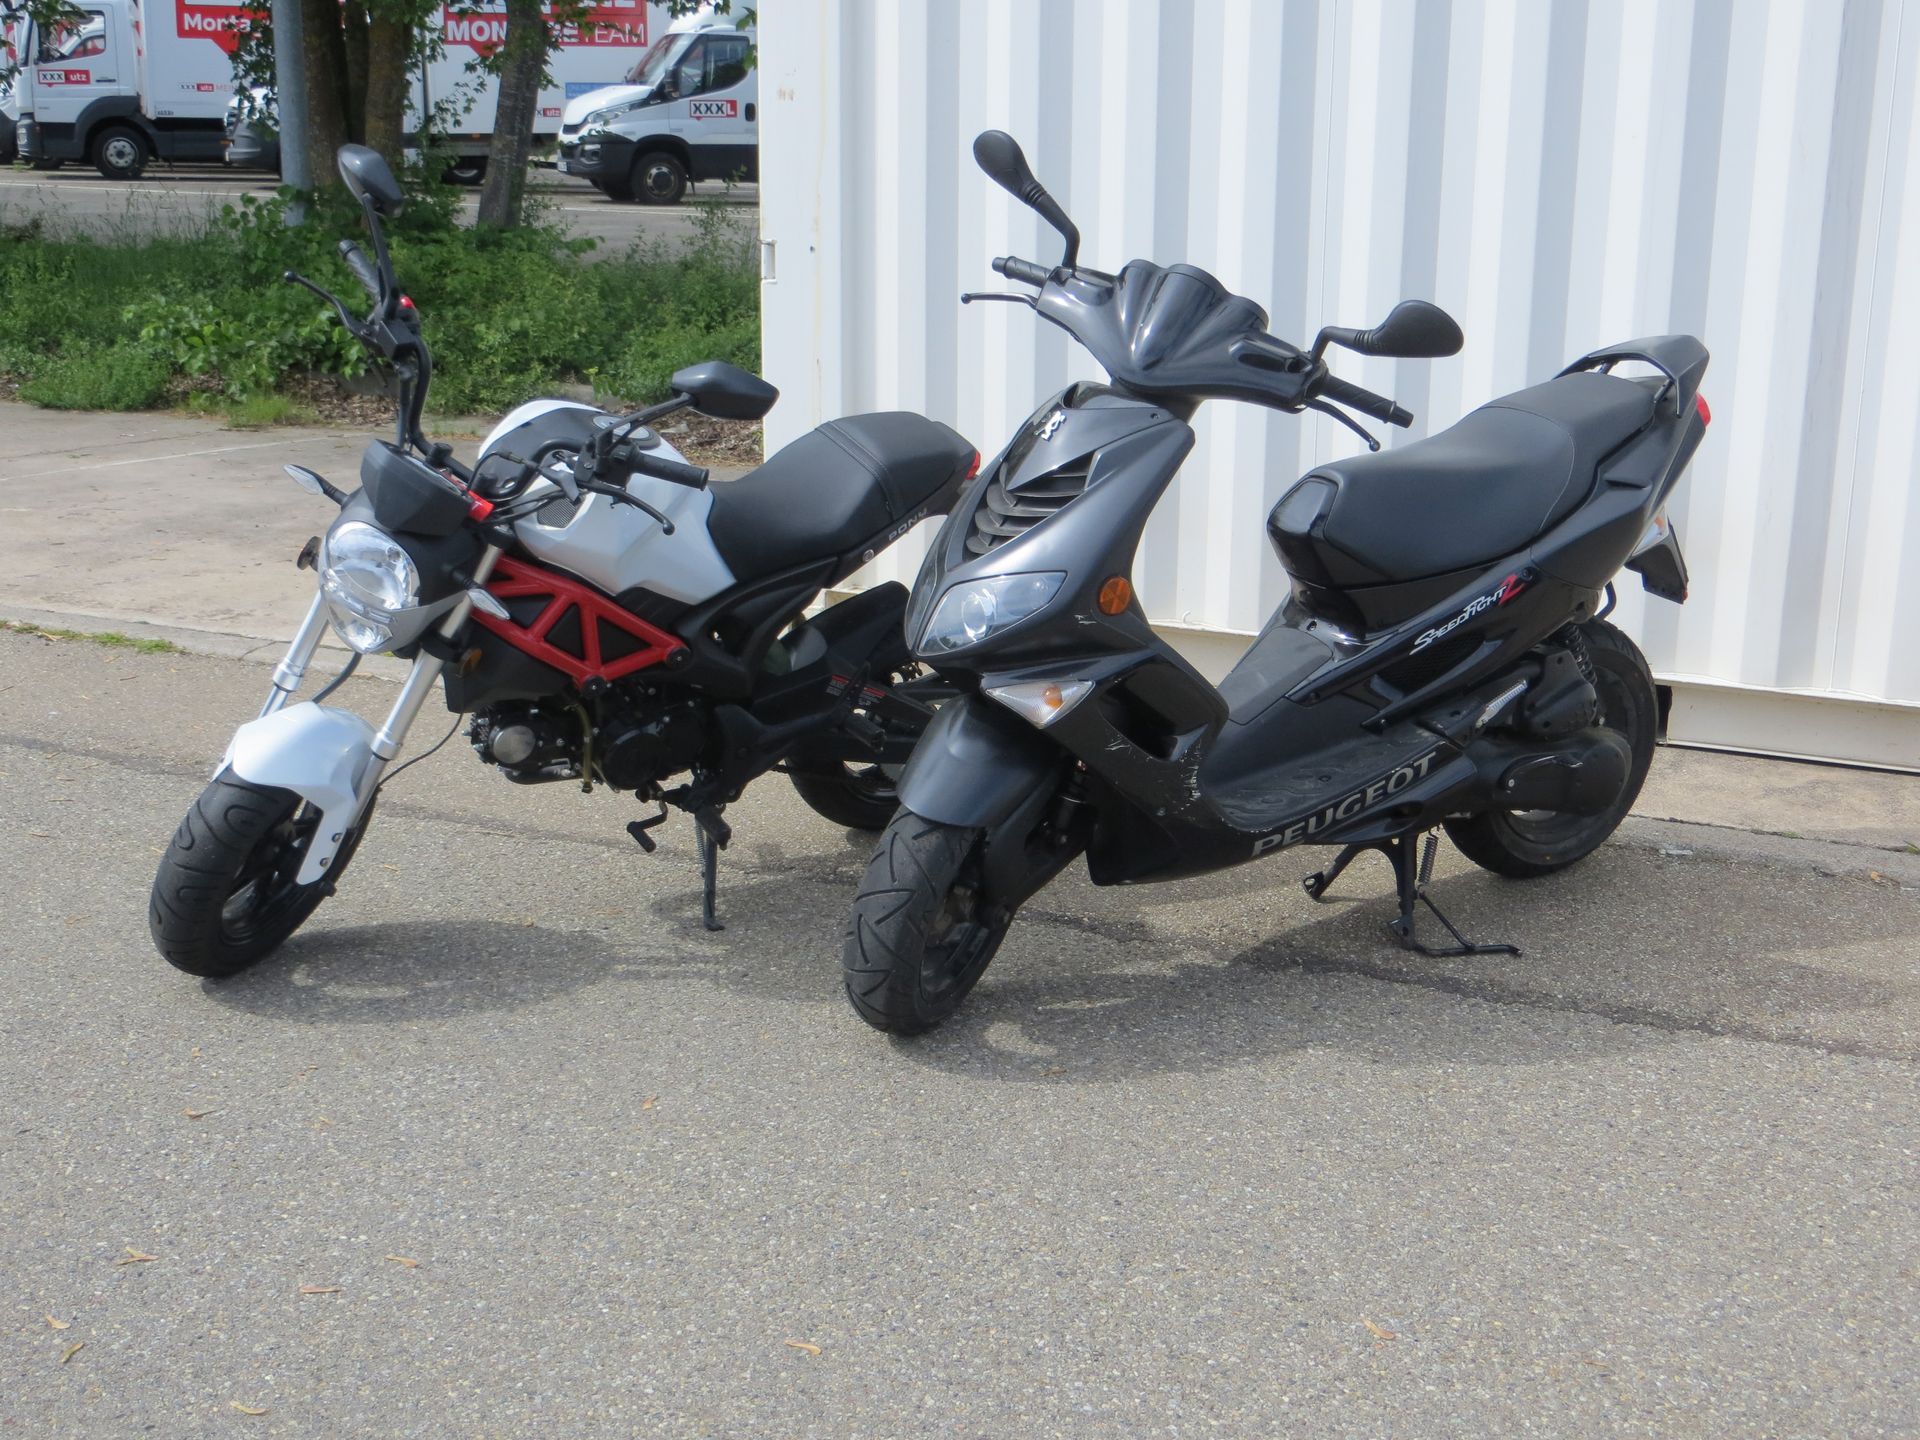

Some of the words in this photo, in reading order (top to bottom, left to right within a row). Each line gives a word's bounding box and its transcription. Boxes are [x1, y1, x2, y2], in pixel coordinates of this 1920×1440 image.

[184, 13, 252, 31] Monta
[692, 103, 735, 115] XXXL
[888, 507, 928, 539] PONY
[1251, 752, 1436, 857] PEUGEOT
